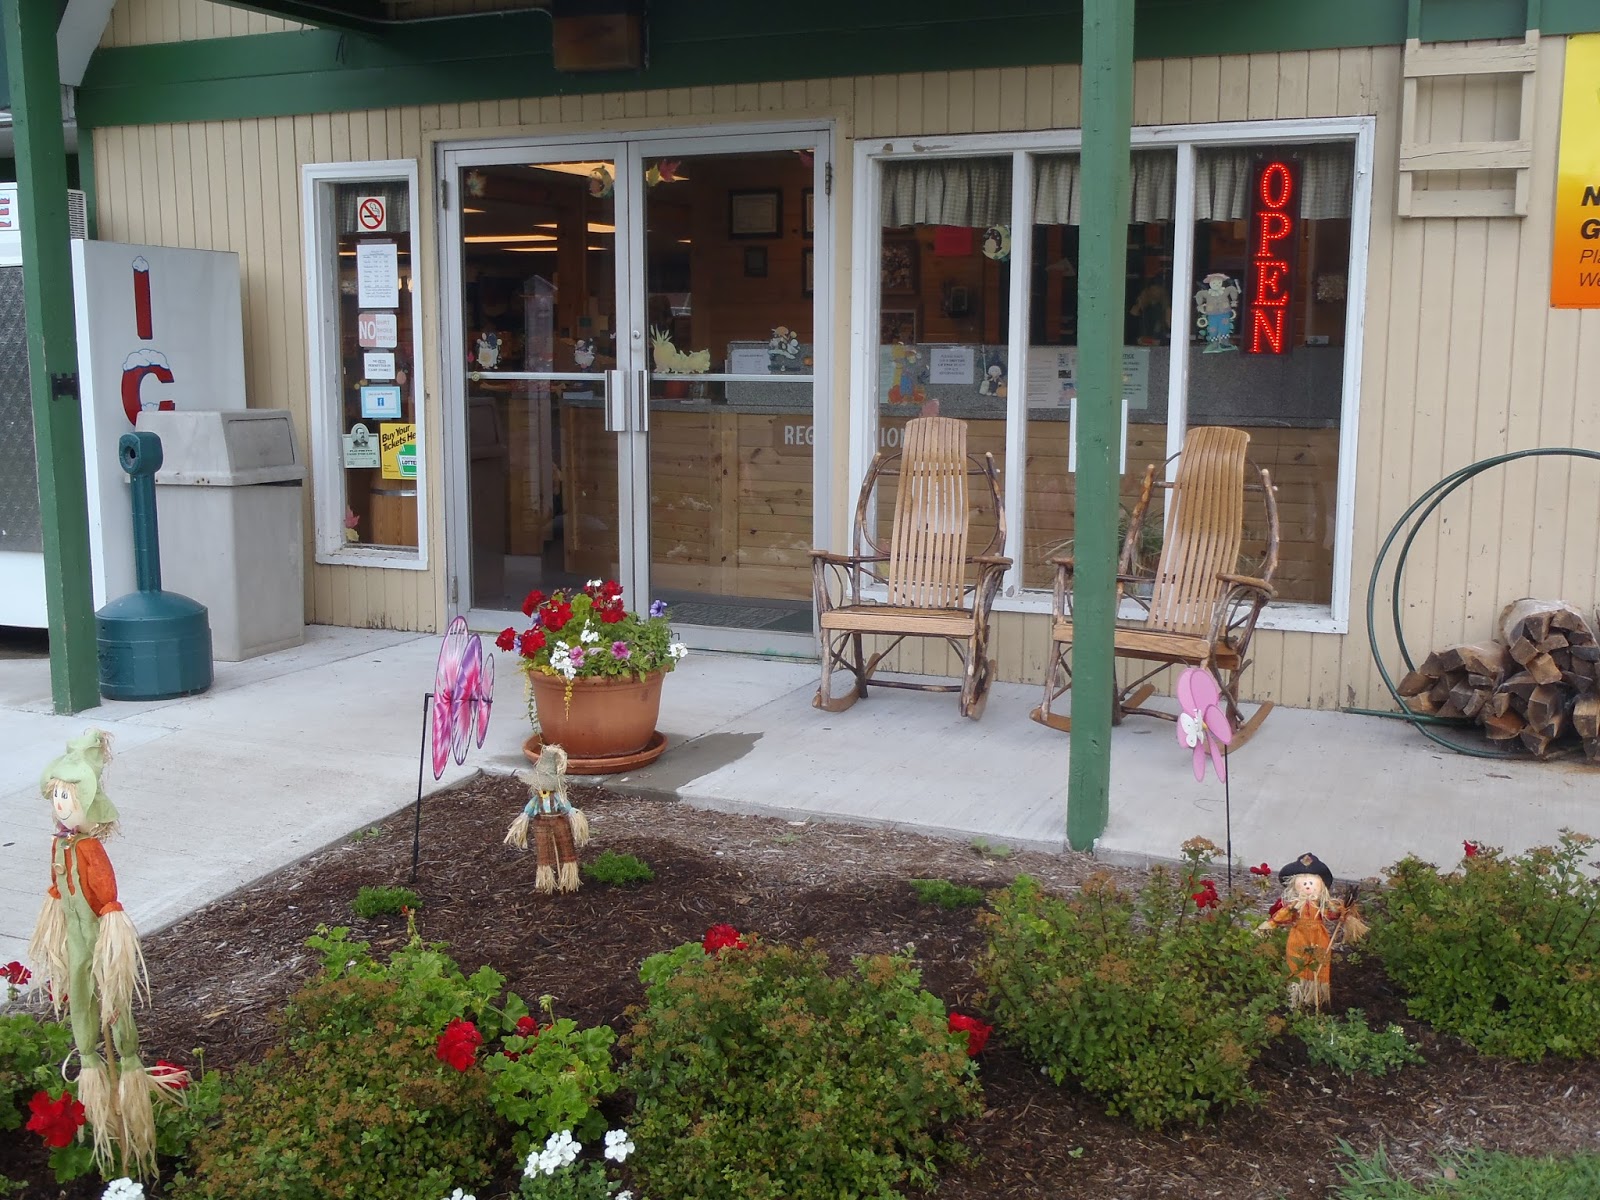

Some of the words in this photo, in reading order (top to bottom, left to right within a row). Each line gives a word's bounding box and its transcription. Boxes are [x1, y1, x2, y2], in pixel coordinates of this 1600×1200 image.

[1250, 162, 1292, 355] OPEN
[359, 320, 376, 340] NO
[382, 431, 396, 443] Buy
[395, 425, 411, 436] Your
[383, 436, 407, 452] Tickets
